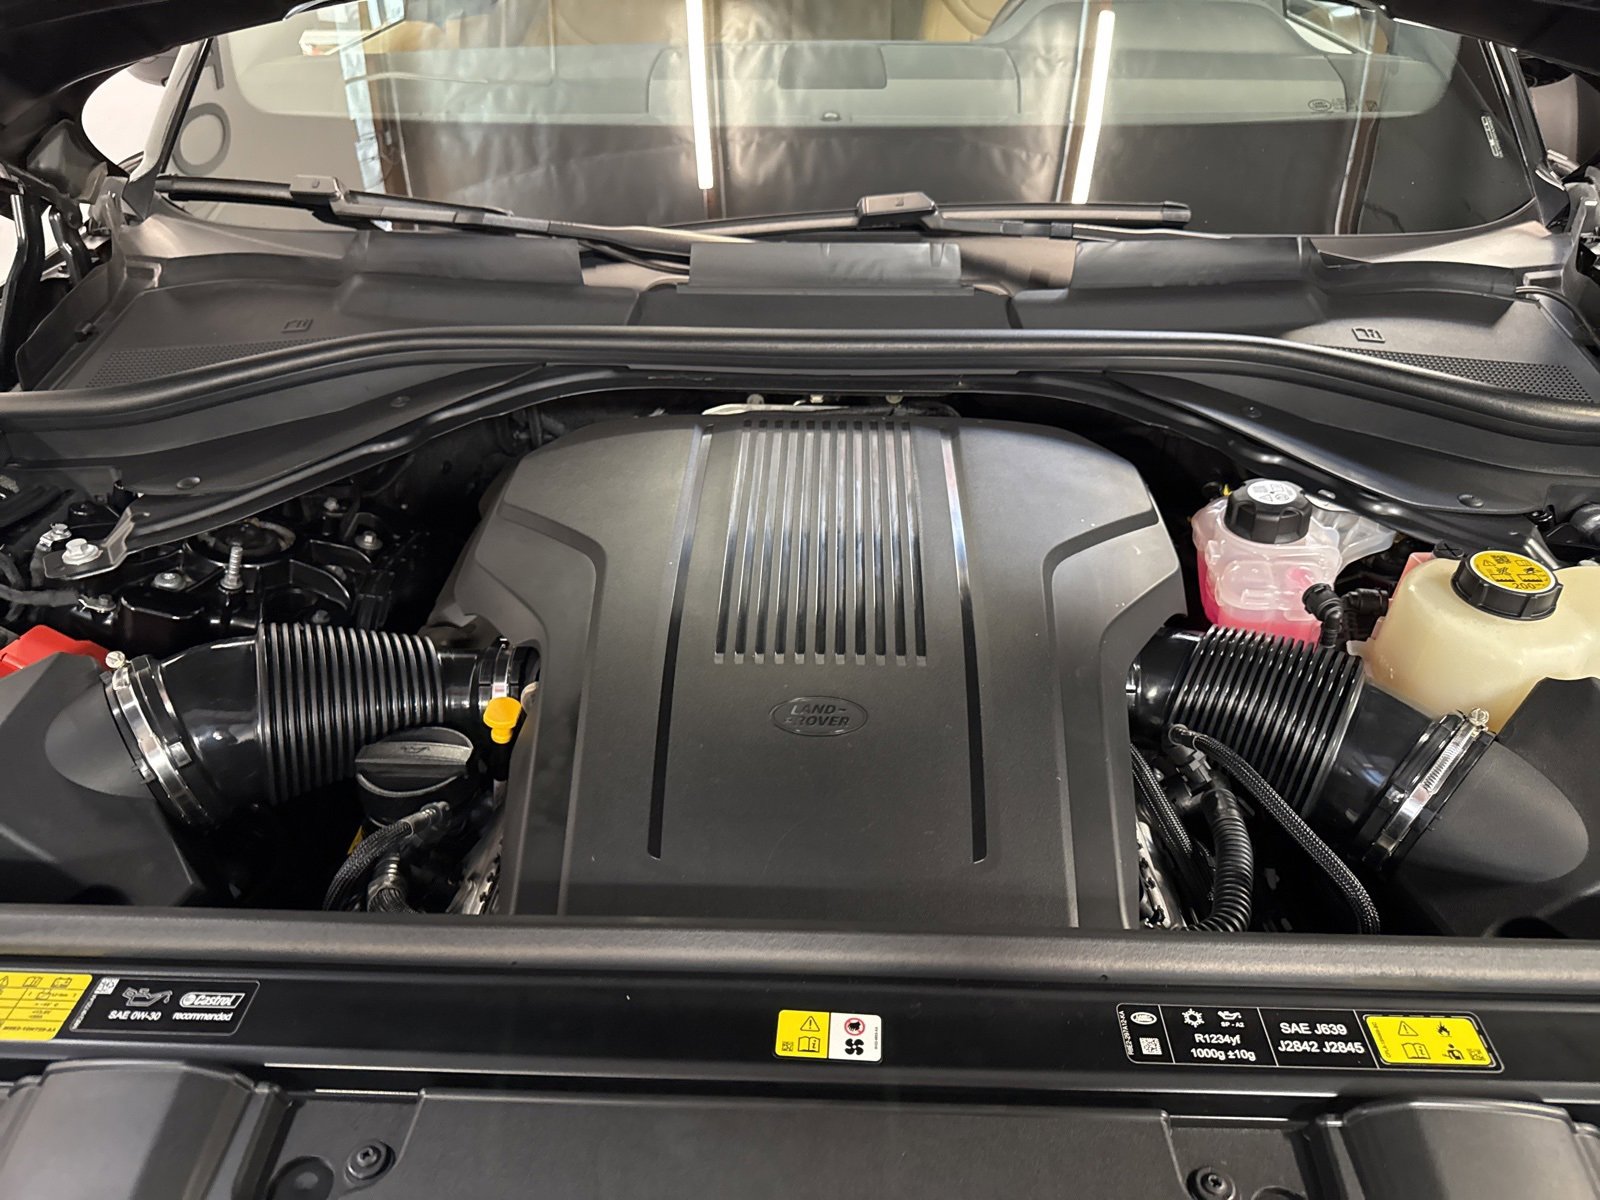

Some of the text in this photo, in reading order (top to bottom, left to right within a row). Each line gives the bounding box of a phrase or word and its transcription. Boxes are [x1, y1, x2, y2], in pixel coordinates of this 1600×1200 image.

[193, 994, 236, 1006] Castrol
[108, 1009, 162, 1021] SAE 0W-30
[172, 1011, 234, 1021] recommended
[1279, 1022, 1348, 1036] SAE J639
[1194, 1033, 1241, 1046] R1234yf
[1278, 1040, 1365, 1054] J2842 J2845
[1190, 1047, 1257, 1062] 1000g ±10g
